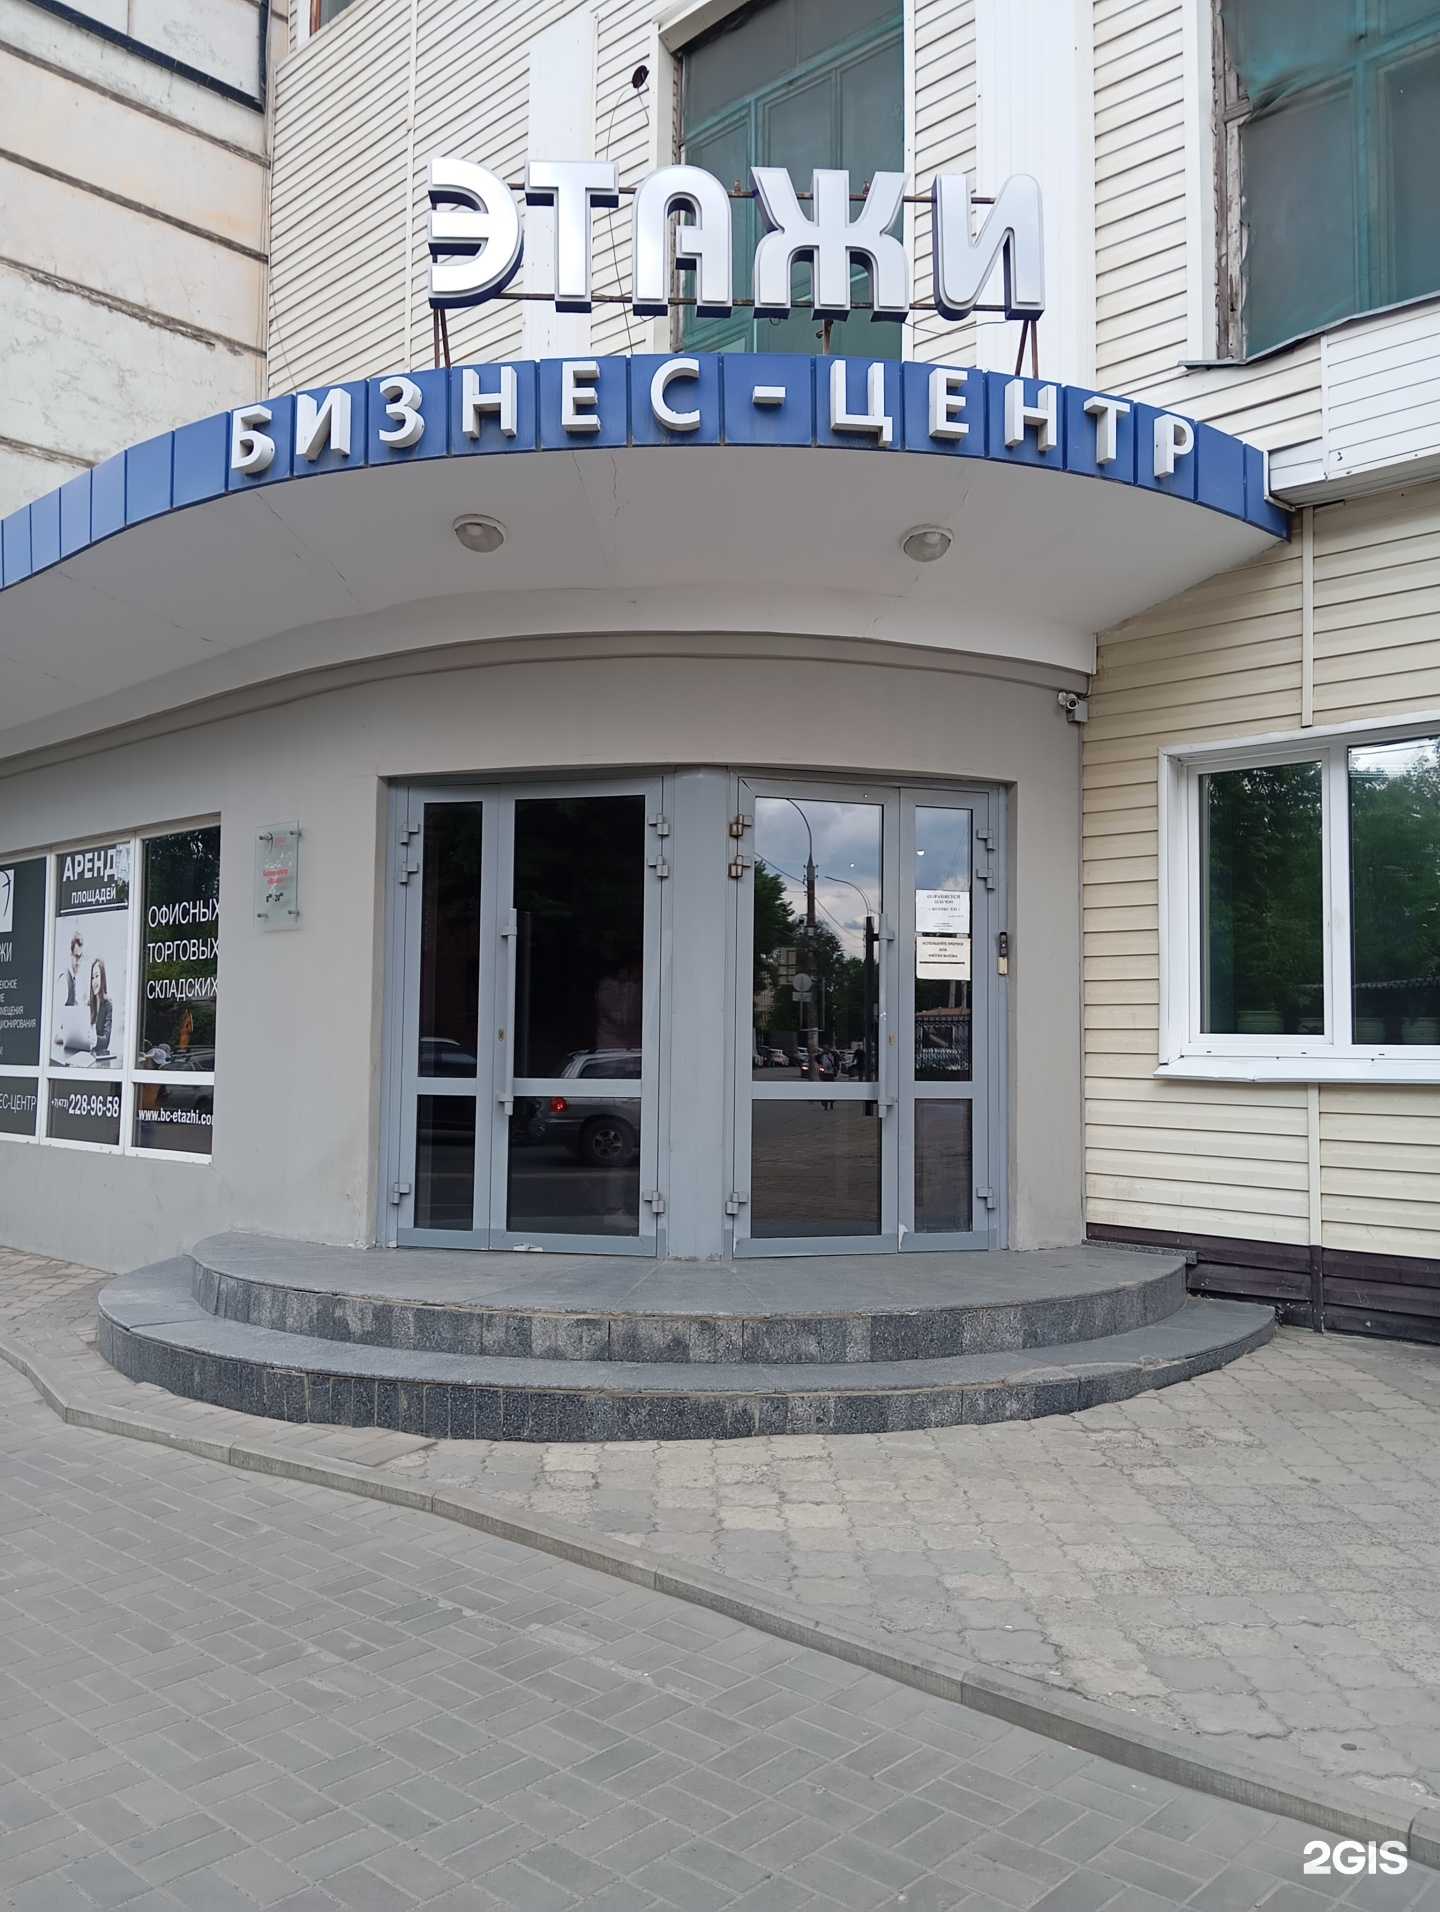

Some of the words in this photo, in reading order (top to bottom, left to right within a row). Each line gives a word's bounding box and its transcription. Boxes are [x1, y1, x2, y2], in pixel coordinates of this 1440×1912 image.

[428, 158, 1045, 322] ЭТАЖИ
[62, 849, 119, 882] АРЕНД
[71, 883, 117, 905] ПЛОЩАДЕЙ
[147, 938, 219, 963] ТОРГОВЫХ
[146, 977, 218, 1001] СКЛАДСКИХ
[69, 1093, 120, 1118] 228-96-58
[138, 1107, 214, 1126] www.bc-etazhi.co
